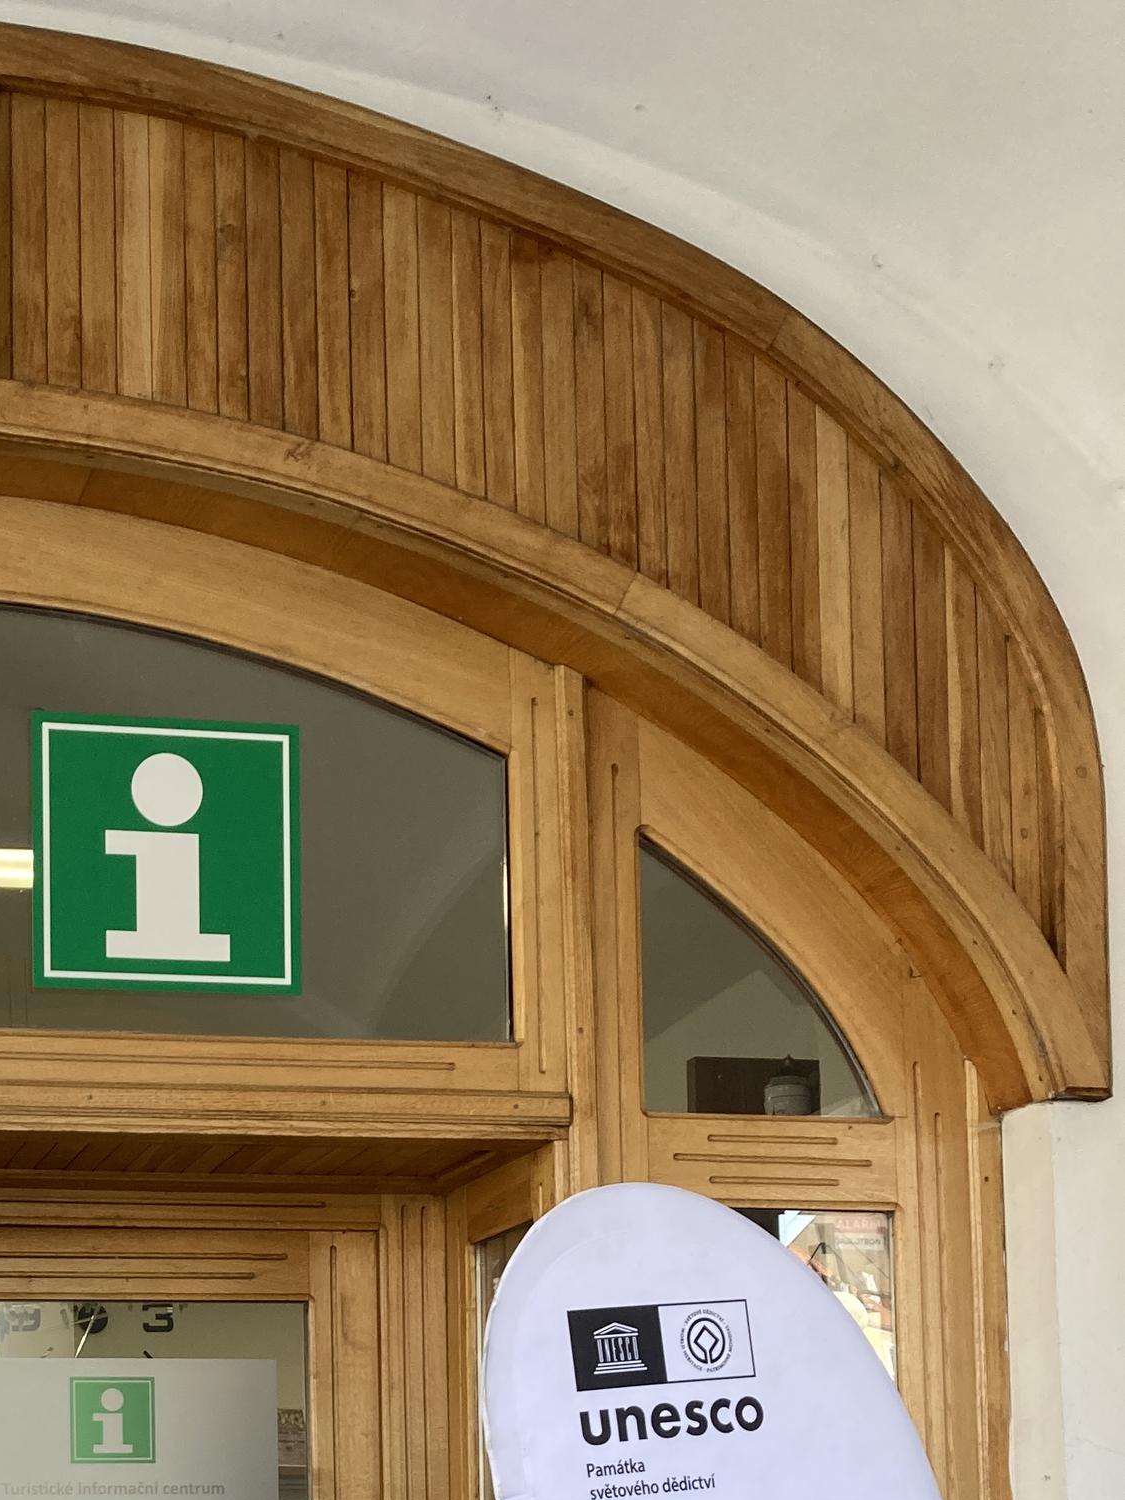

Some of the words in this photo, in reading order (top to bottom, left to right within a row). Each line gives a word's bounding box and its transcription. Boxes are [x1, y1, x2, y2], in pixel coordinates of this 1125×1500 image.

[105, 752, 231, 962] i
[92, 1388, 133, 1454] i
[579, 1396, 764, 1446] unesco
[586, 1458, 646, 1478] Památka
[590, 1480, 659, 1500] světového
[662, 1473, 716, 1493] dědictví
[1, 1480, 73, 1496] Turistické
[163, 1483, 225, 1496] centrum
